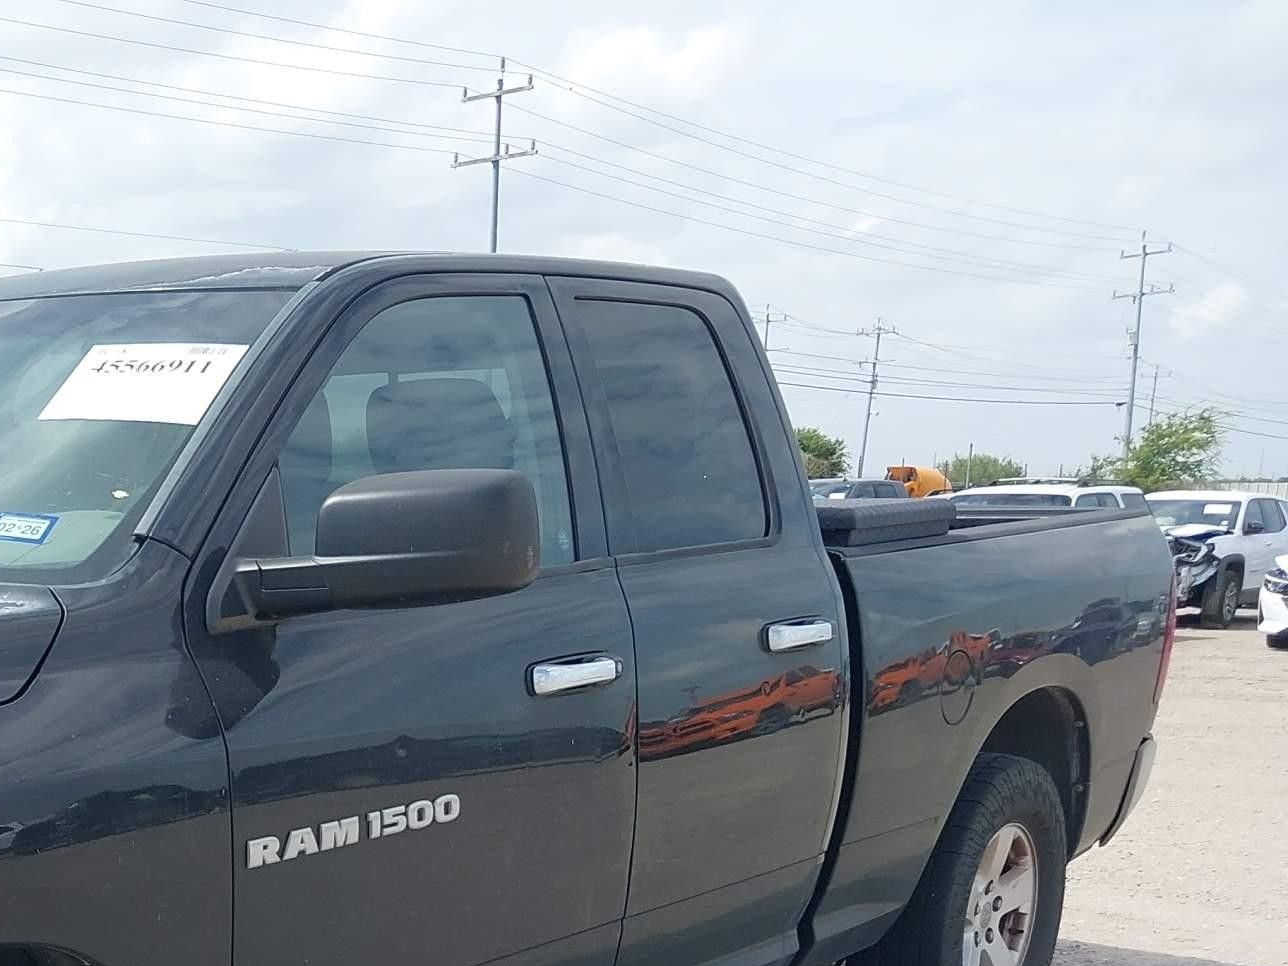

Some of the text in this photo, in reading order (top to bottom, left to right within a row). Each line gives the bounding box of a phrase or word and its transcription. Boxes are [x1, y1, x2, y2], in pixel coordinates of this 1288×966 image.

[91, 360, 213, 374] 45566911
[20, 524, 42, 536] 26
[246, 793, 461, 869] RAM 1500
